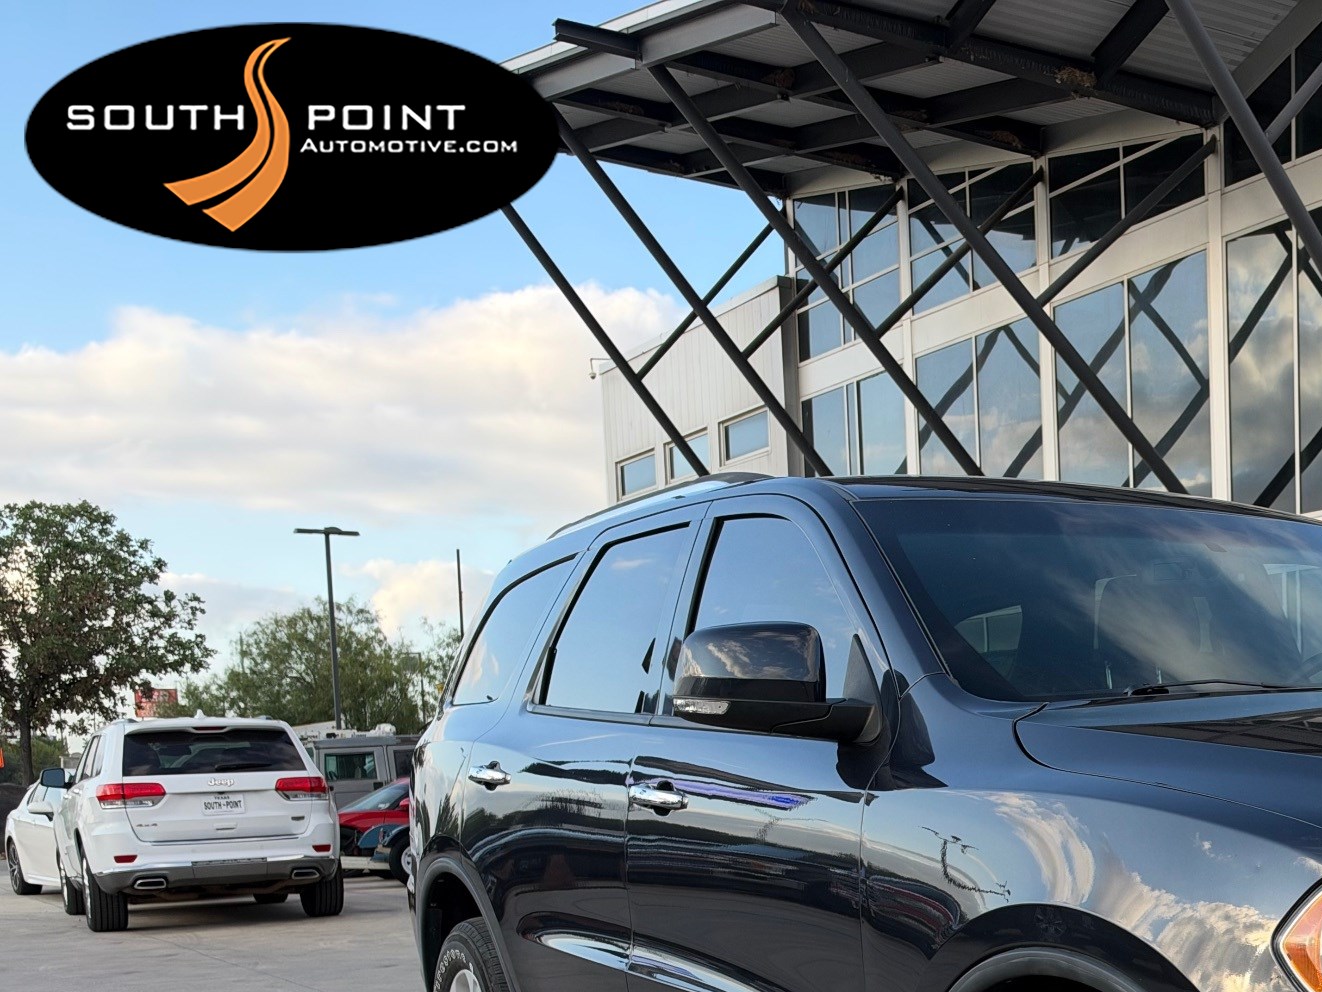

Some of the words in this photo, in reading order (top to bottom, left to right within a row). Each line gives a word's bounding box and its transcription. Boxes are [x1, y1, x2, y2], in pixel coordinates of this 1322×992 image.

[208, 777, 234, 787] Jeep
[203, 801, 222, 810] SOUTH
[226, 800, 242, 809] POINT
